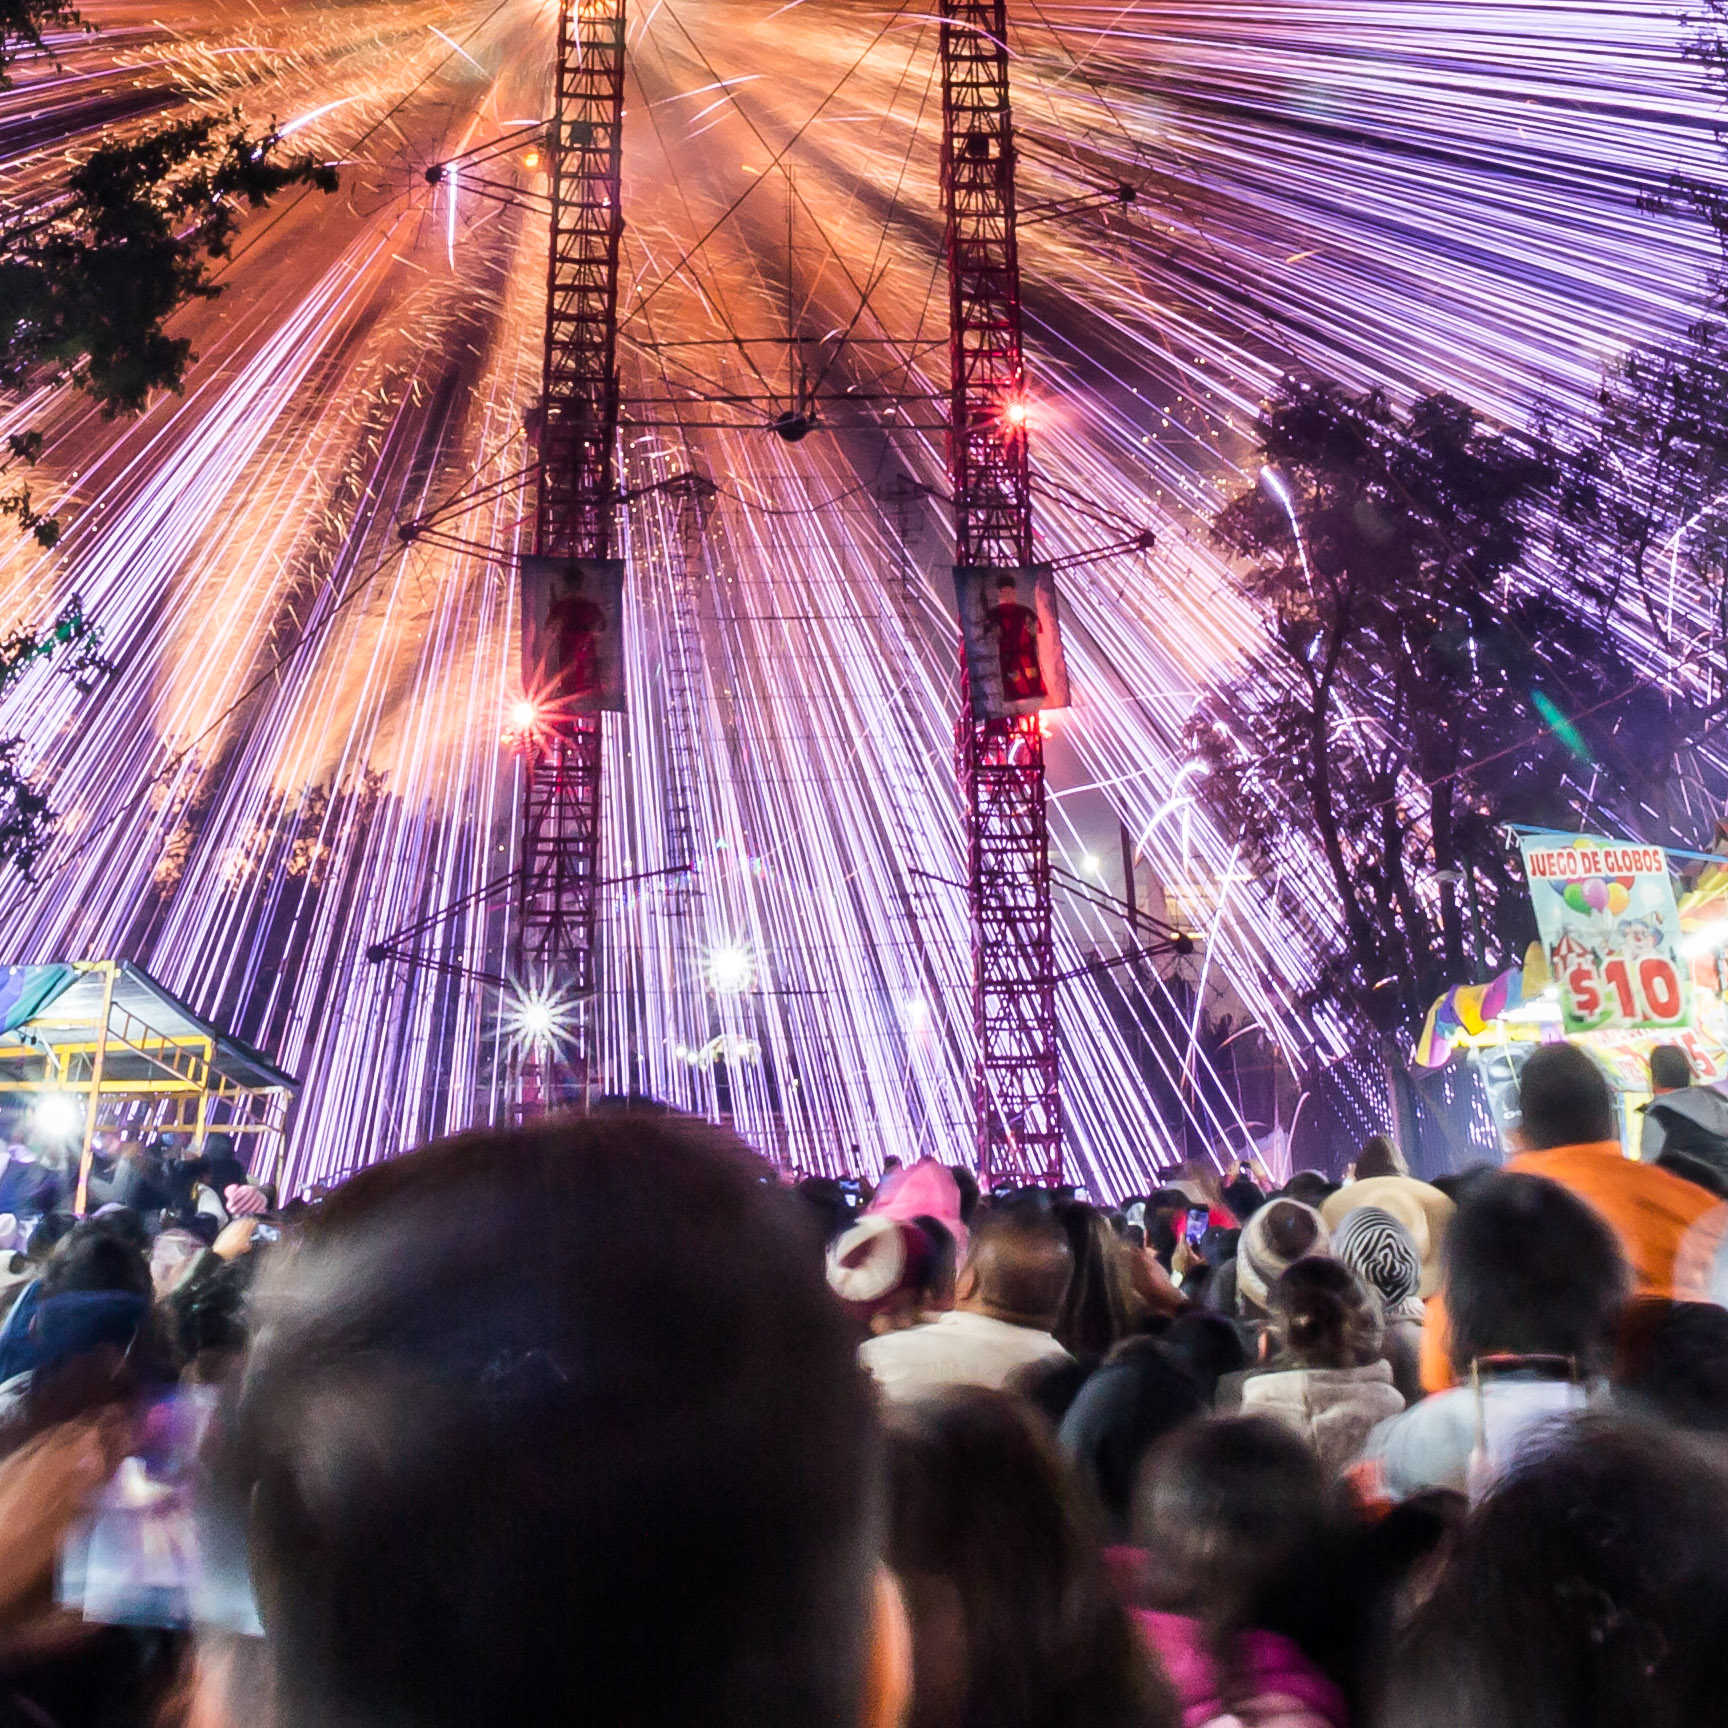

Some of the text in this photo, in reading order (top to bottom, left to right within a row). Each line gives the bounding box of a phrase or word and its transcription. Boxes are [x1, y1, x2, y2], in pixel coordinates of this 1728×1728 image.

[1528, 848, 1663, 877] JUEGO DE GLOBOS
[1568, 957, 1682, 1020] $10
